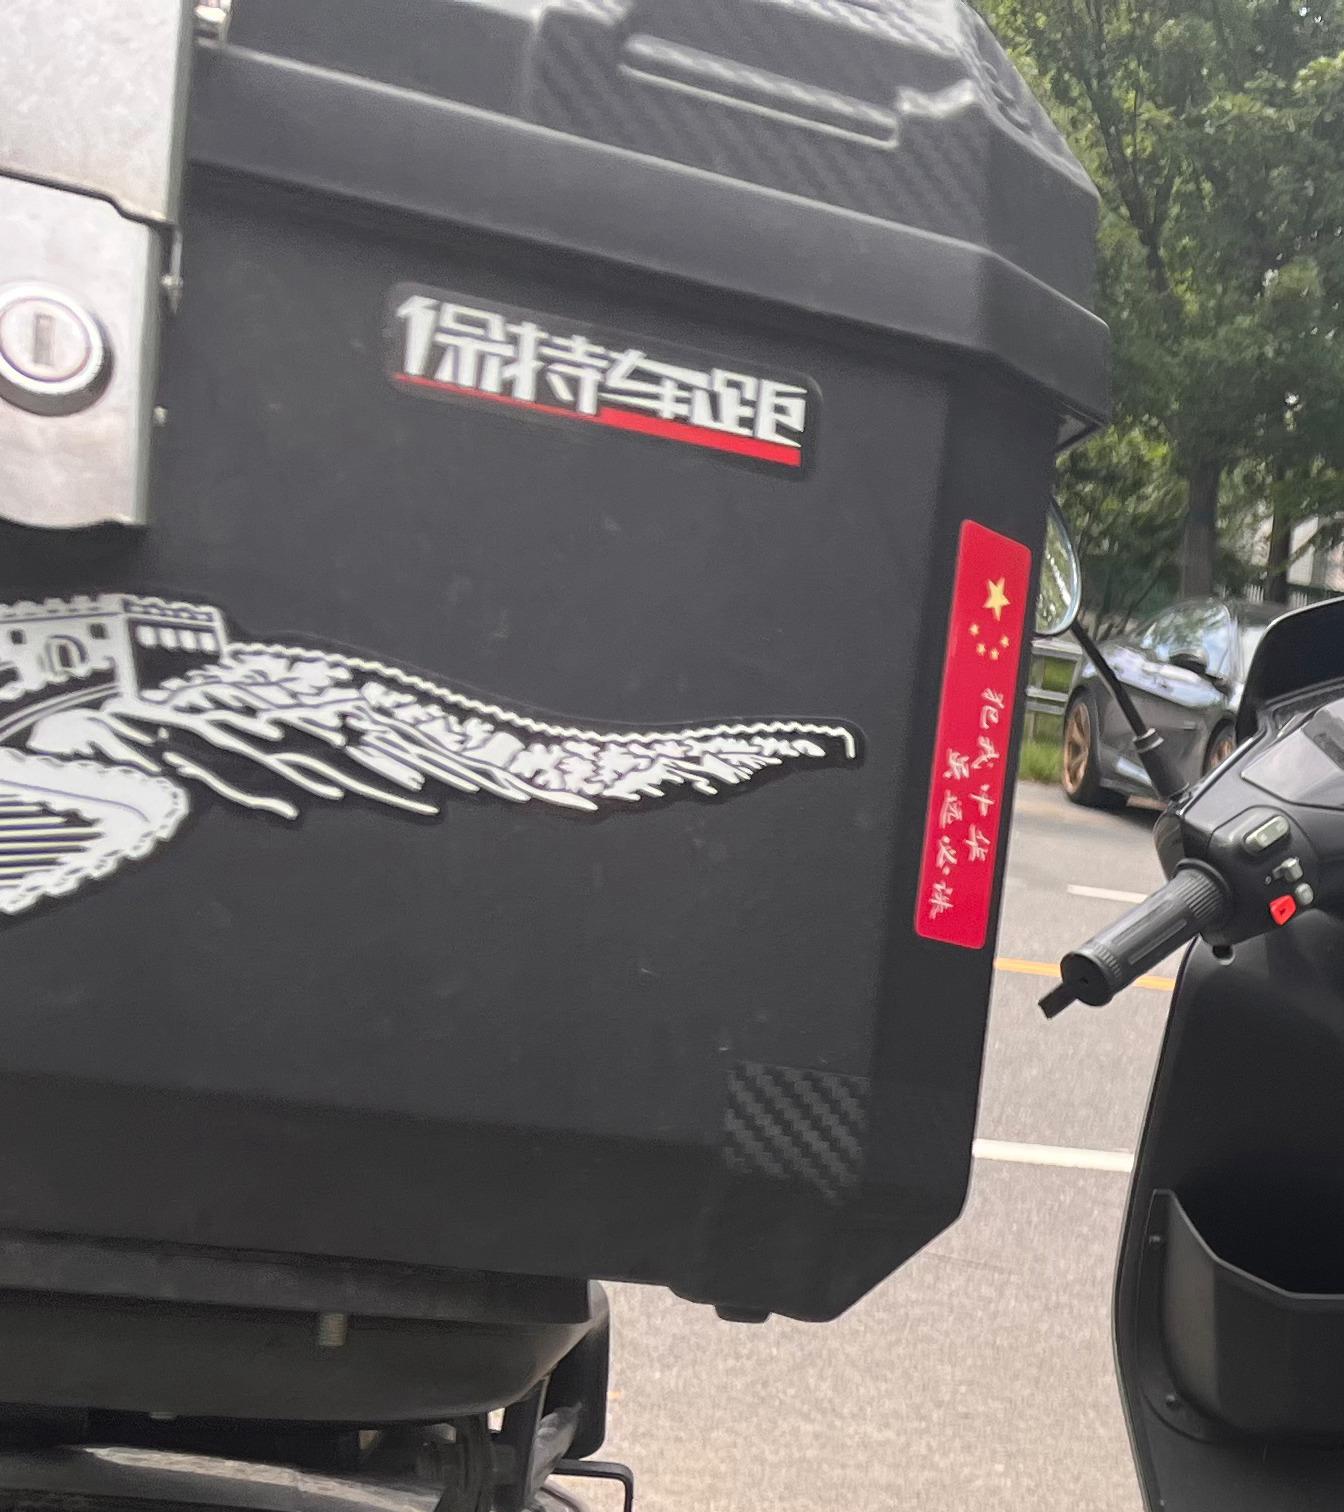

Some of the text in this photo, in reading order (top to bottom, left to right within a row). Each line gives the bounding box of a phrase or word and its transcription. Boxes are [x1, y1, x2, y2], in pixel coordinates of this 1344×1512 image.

[396, 295, 807, 449] 保持车距
[928, 747, 970, 920] 虽远必诛
[963, 688, 1005, 862] 犯我中华
